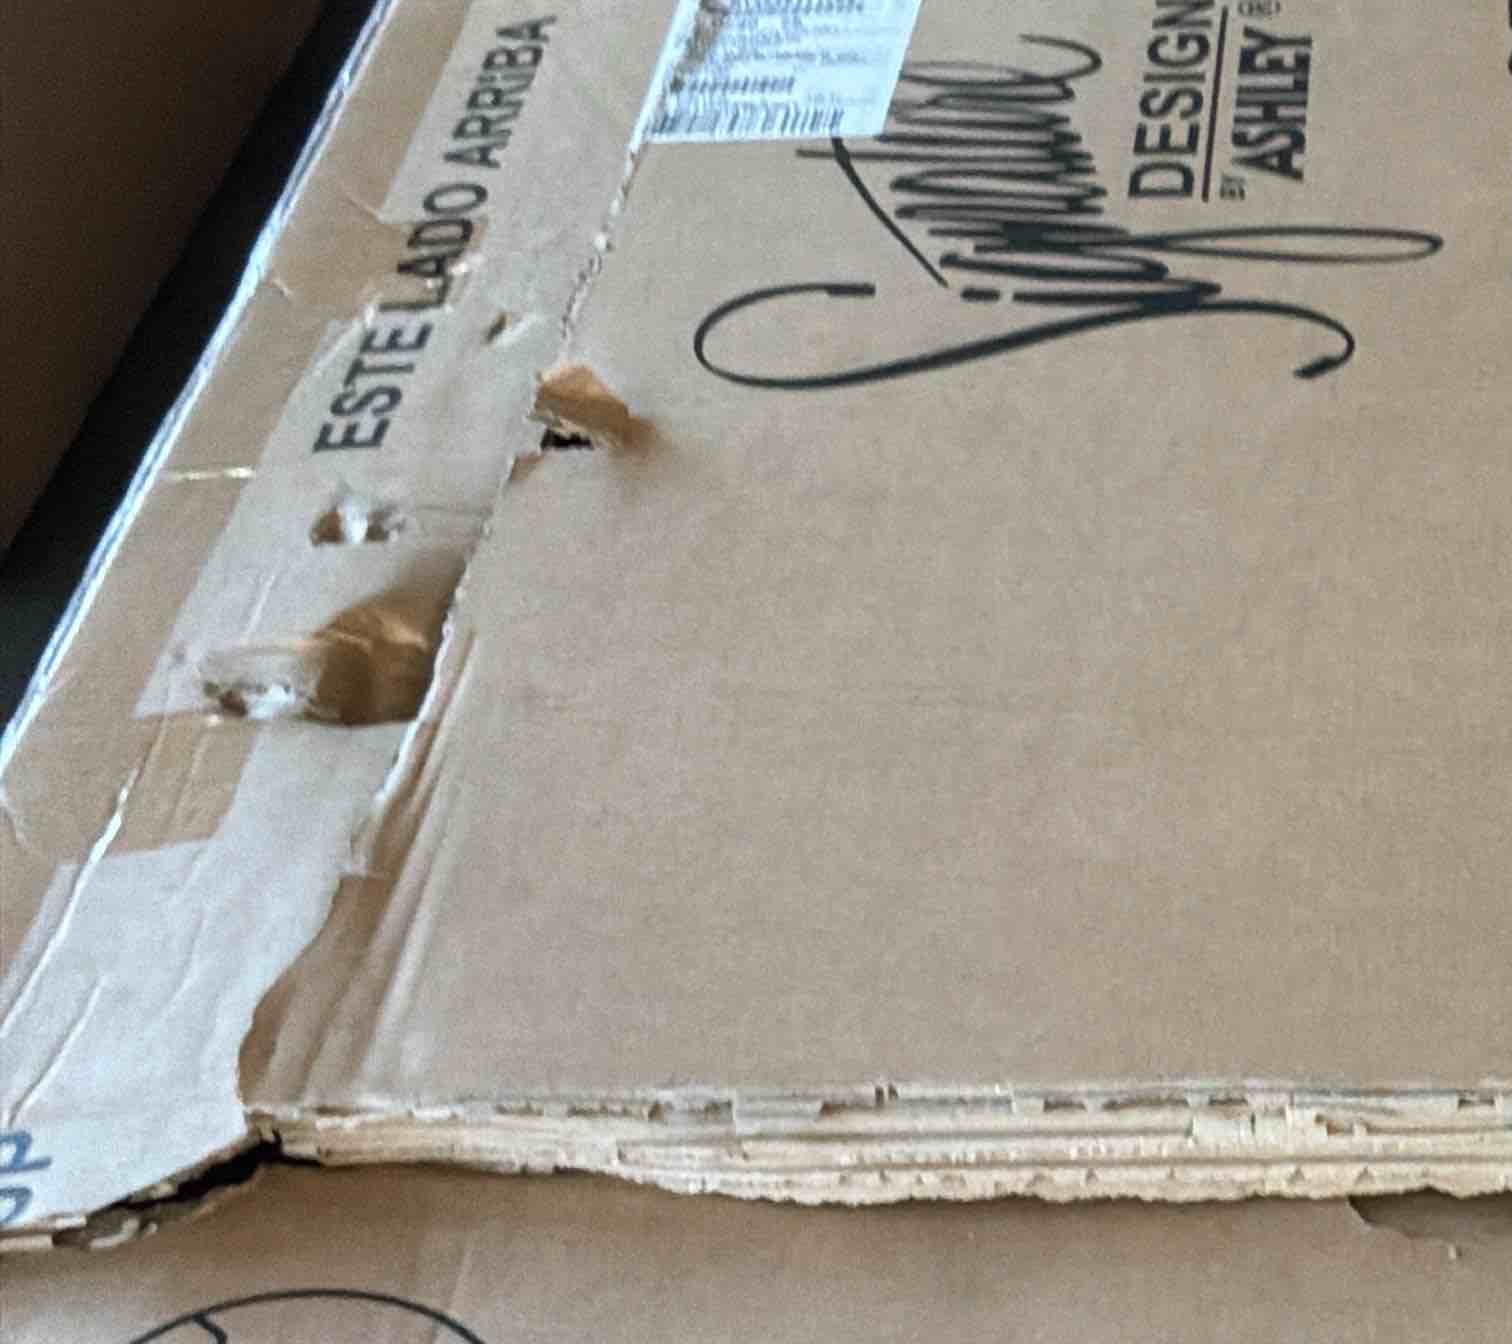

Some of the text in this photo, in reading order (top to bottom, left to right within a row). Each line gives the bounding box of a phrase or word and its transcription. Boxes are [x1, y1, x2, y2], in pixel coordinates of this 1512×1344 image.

[312, 14, 558, 454] ESTE LADO ARRIBA
[1230, 24, 1314, 182] ASHLEY
